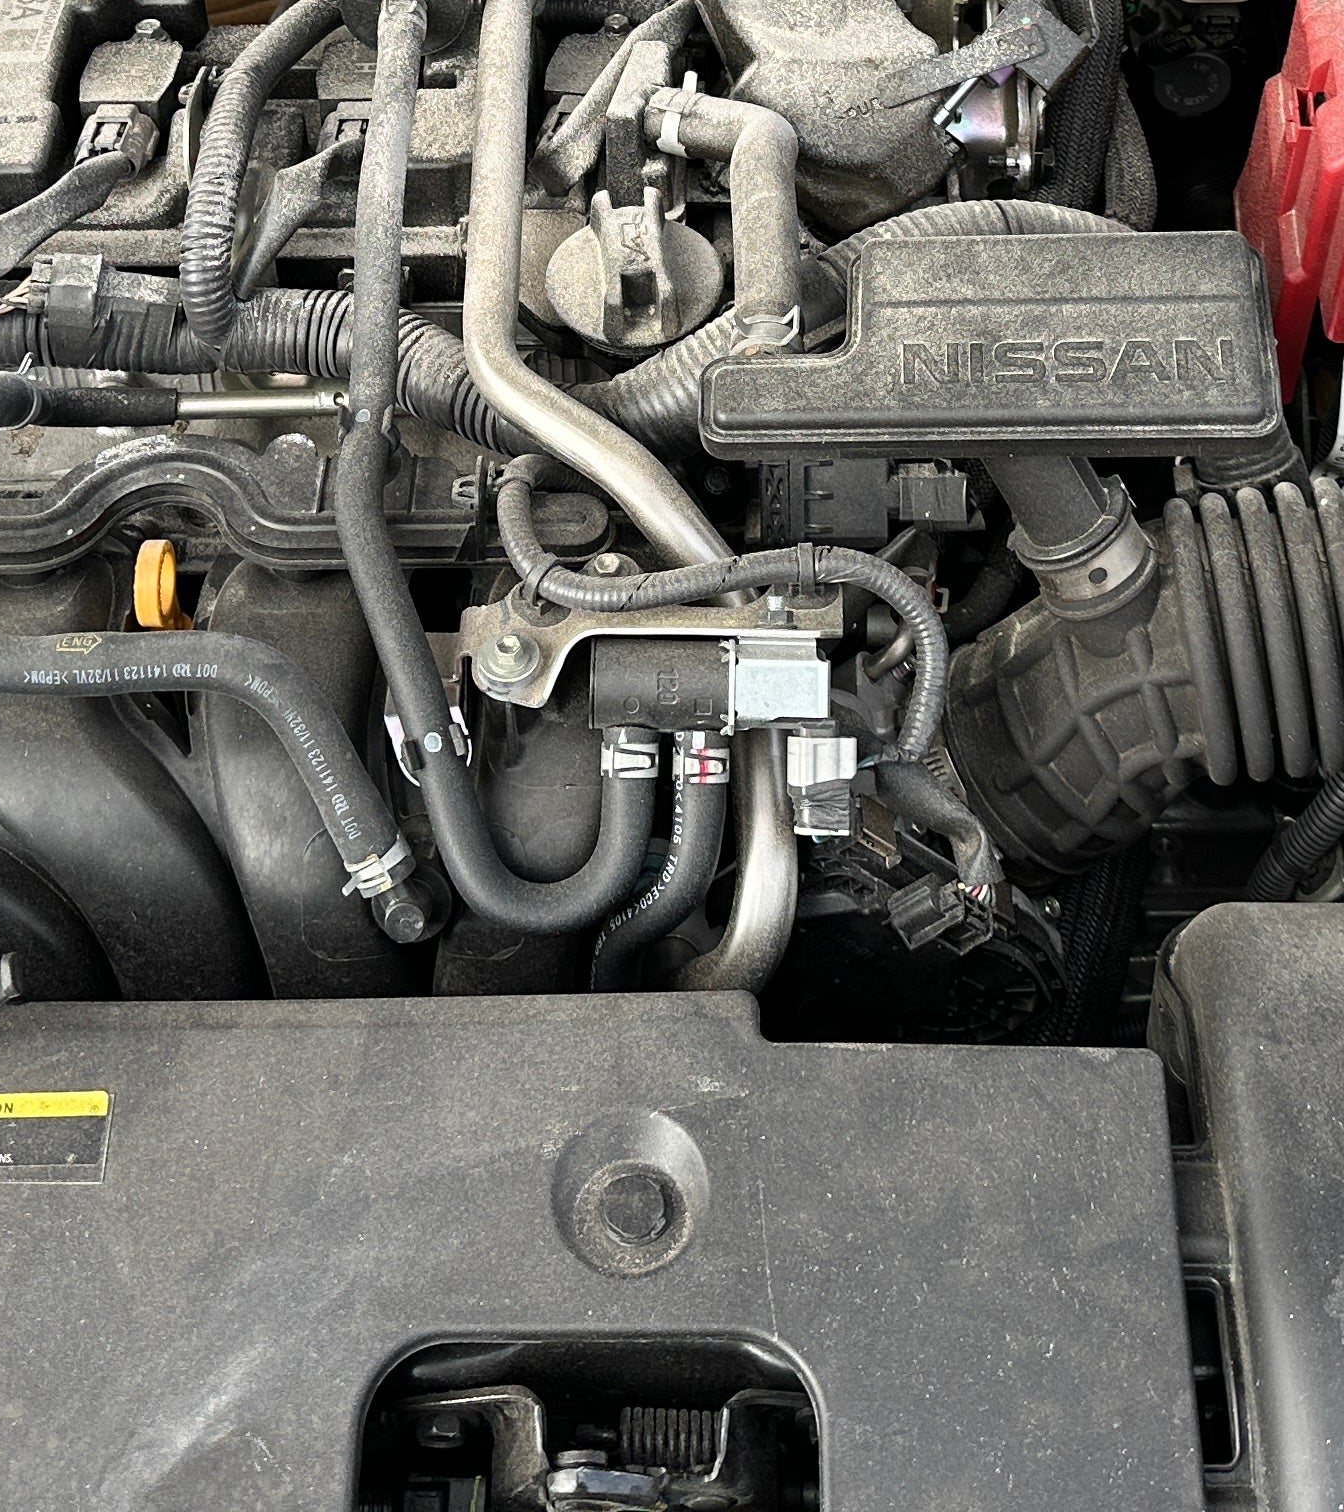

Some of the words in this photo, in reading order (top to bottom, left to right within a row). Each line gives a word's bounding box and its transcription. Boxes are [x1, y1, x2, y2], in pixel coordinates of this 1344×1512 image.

[900, 337, 1234, 386] NISSAN
[124, 664, 167, 681] 141123
[195, 663, 218, 678] DOT
[307, 748, 338, 792] 141123
[340, 816, 362, 840] DOT
